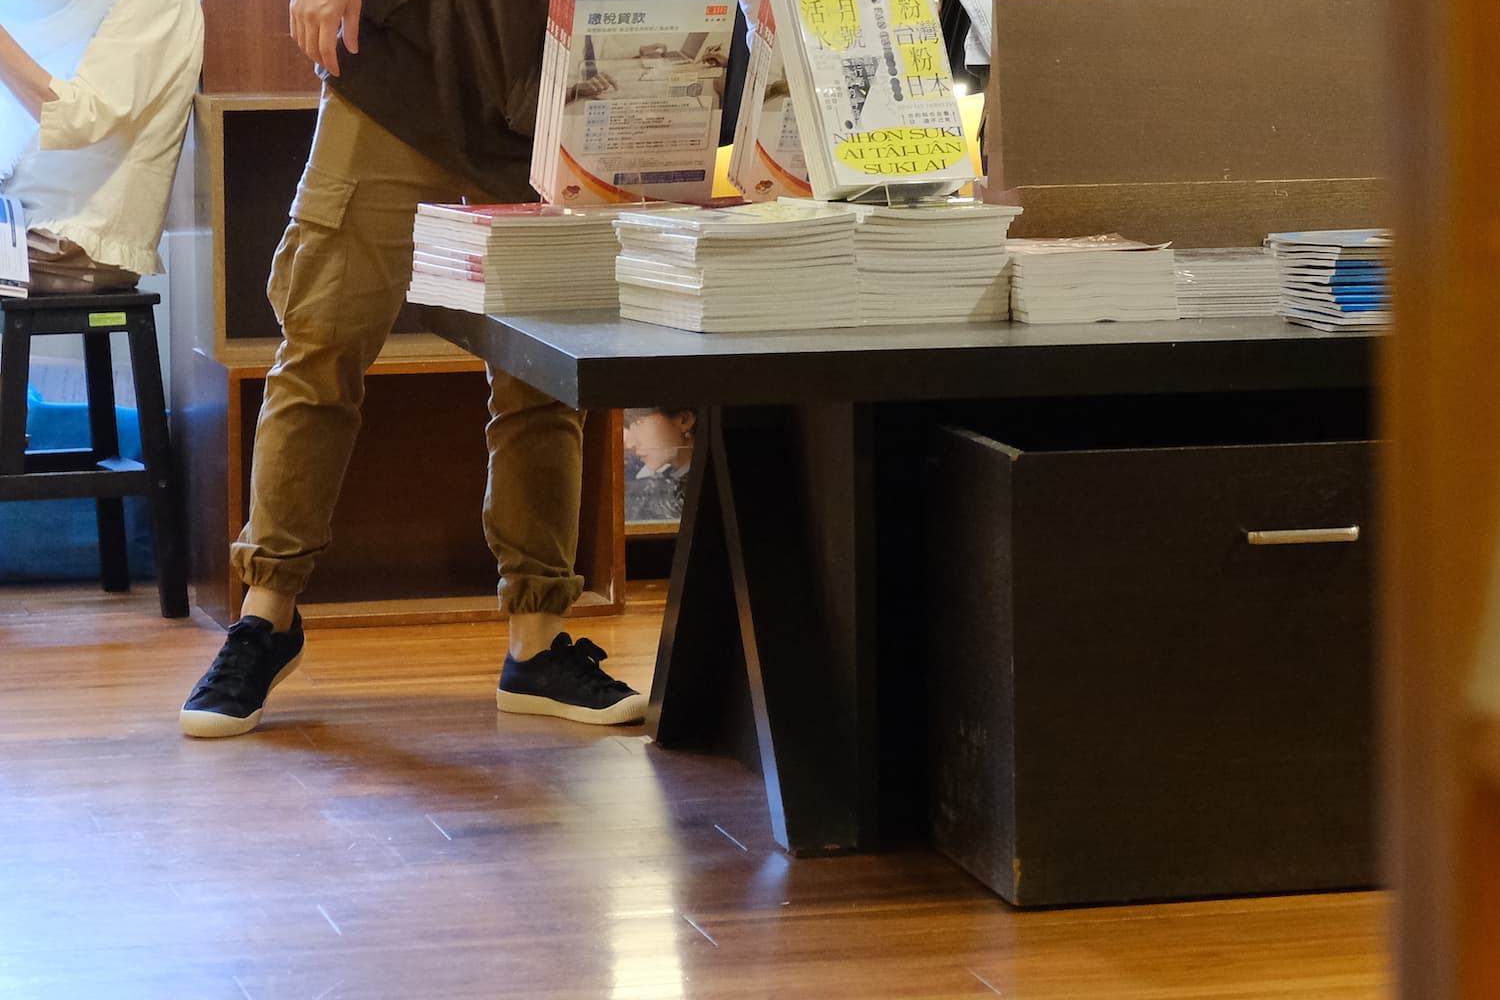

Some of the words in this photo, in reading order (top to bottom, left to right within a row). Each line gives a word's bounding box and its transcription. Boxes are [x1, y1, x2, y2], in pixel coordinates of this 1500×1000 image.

[833, 129, 905, 146] NIHON
[908, 125, 963, 142] SUKI
[863, 161, 918, 176] SUKI
